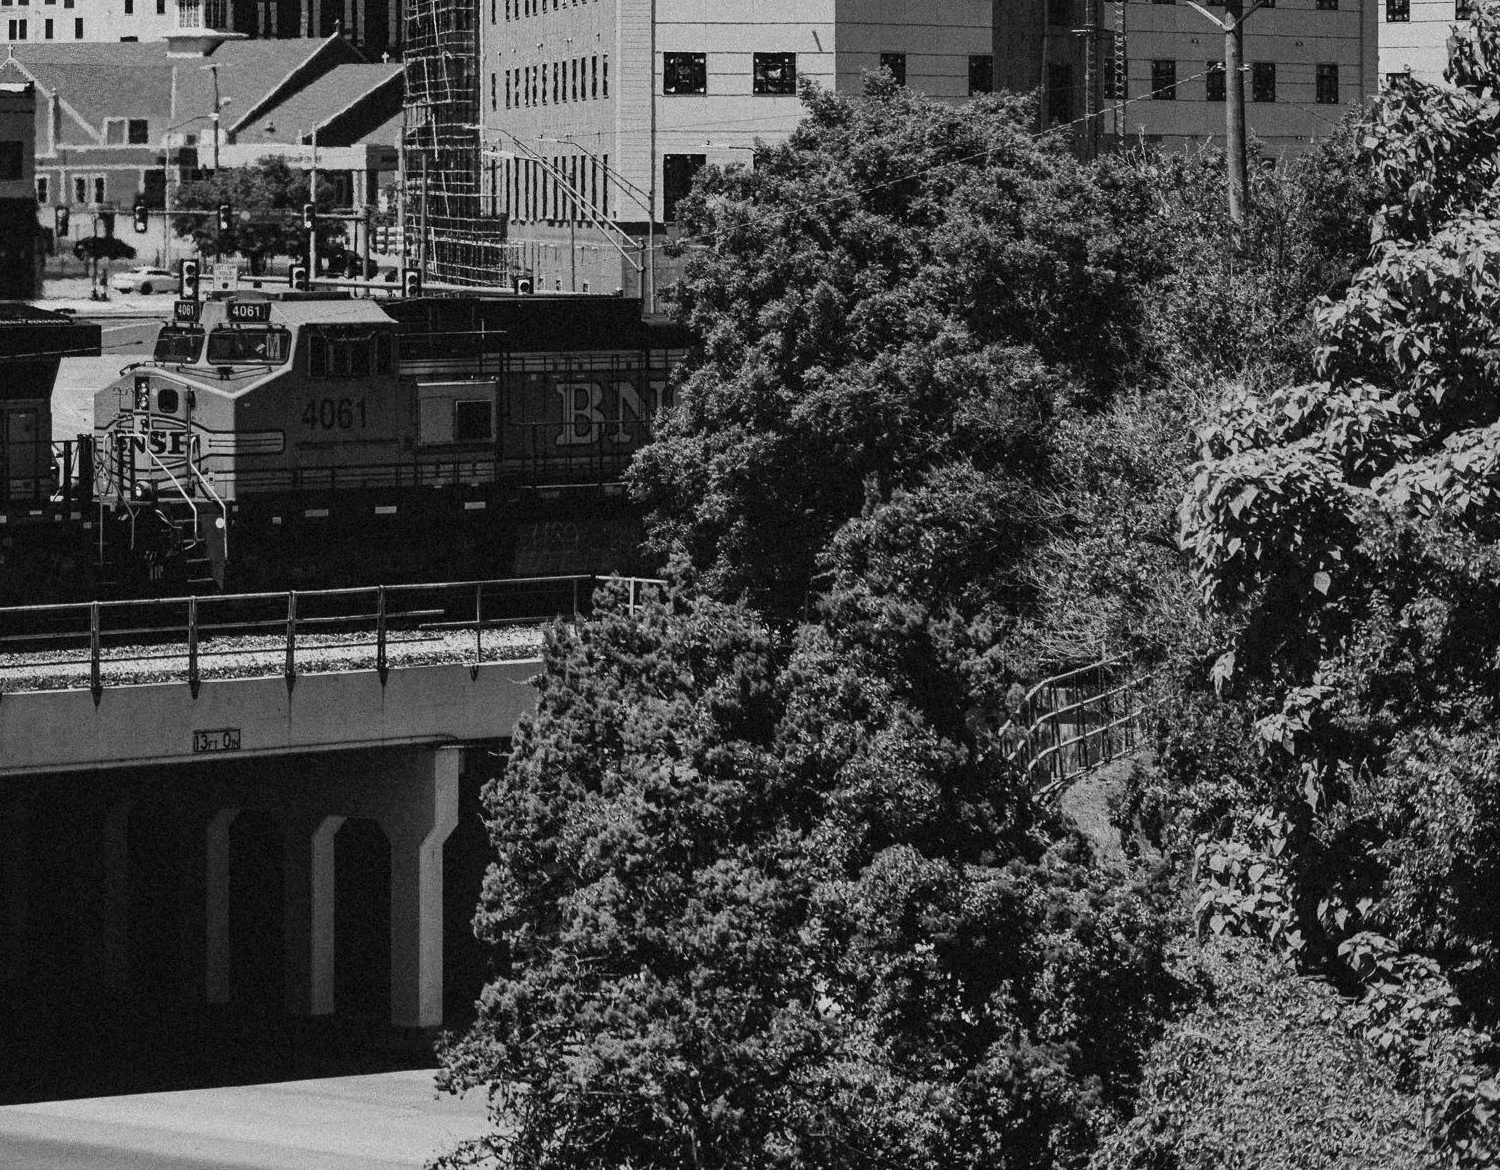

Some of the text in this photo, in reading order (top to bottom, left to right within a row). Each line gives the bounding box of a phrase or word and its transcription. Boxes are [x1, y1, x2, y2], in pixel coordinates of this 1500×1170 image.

[177, 303, 195, 316] 4061
[232, 305, 261, 318] 4061
[302, 396, 368, 430] 4061
[555, 381, 682, 445] BN
